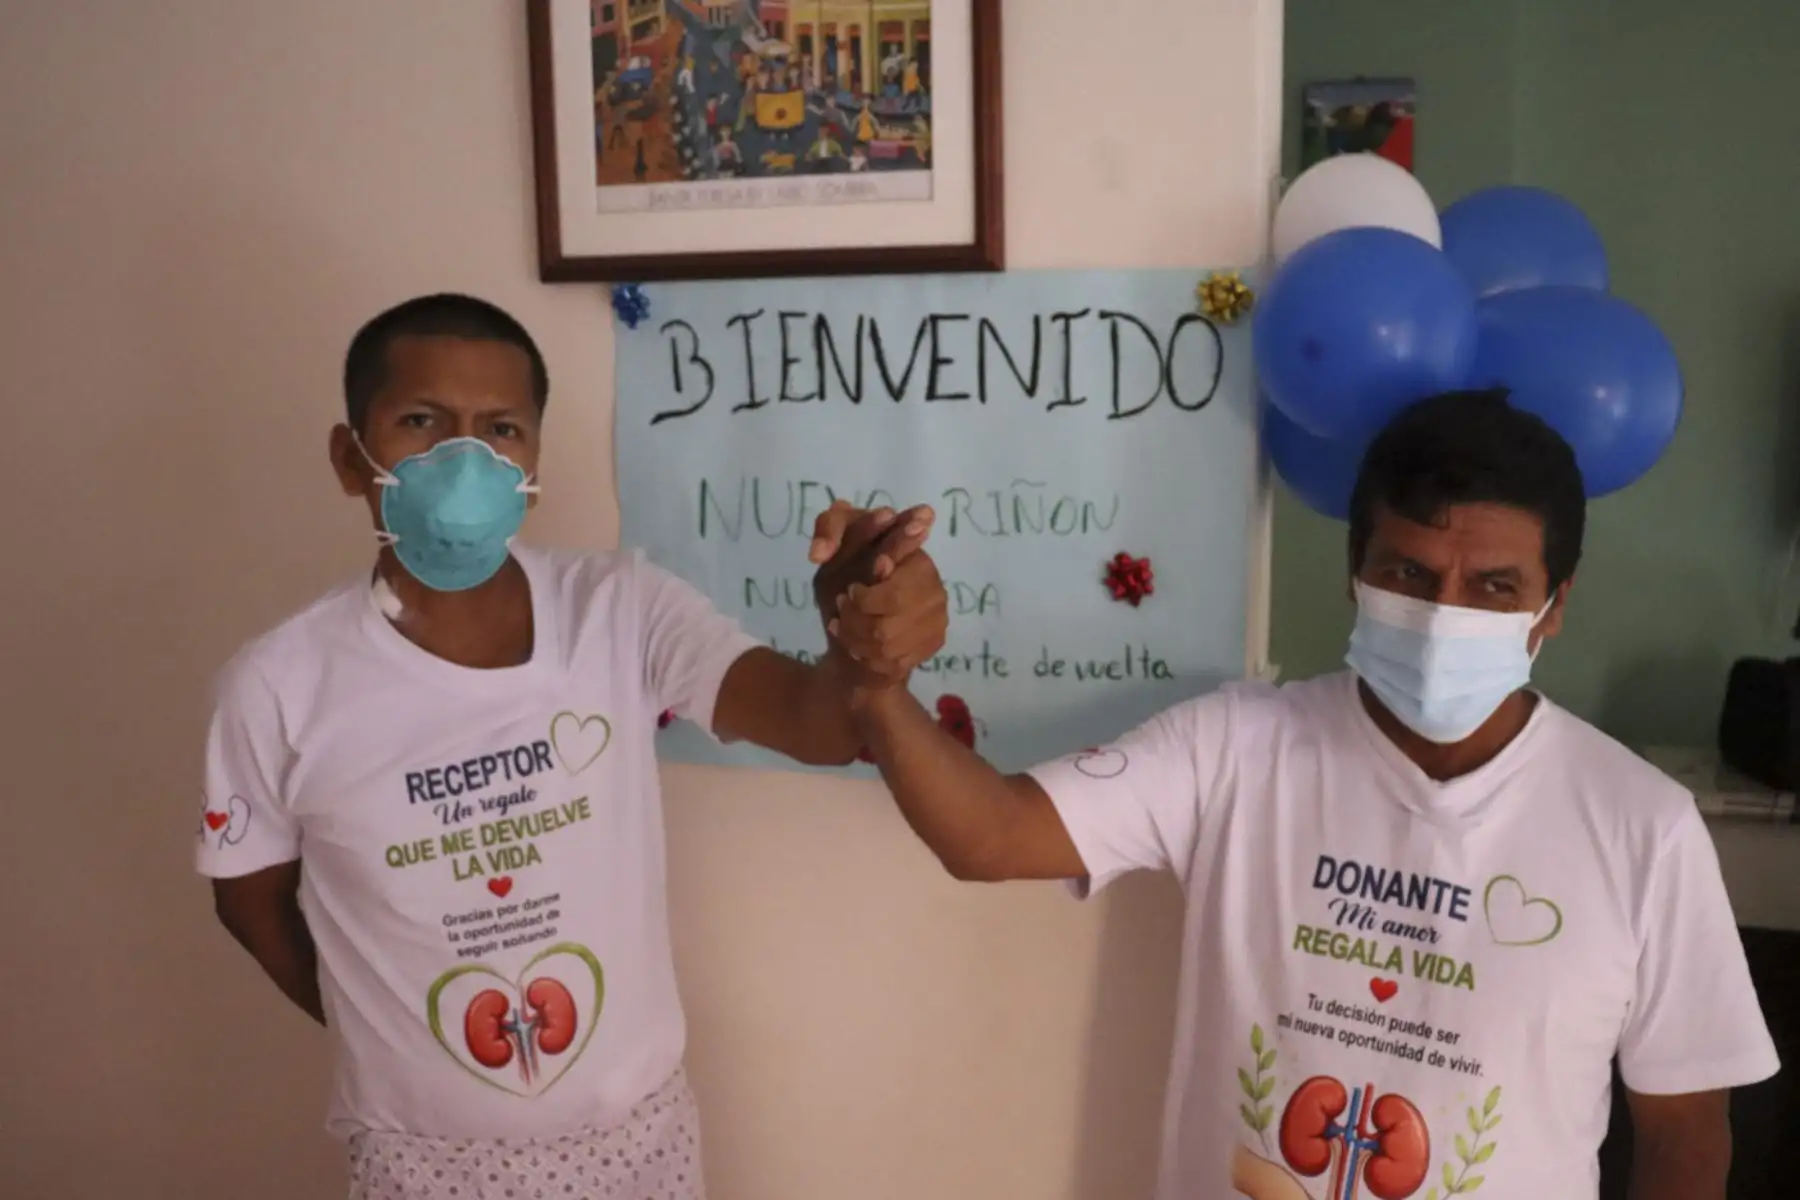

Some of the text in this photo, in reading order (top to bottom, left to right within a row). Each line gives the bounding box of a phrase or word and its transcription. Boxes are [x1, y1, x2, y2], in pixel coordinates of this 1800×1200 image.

[649, 308, 1225, 427] BIENVENIDO
[942, 479, 1121, 538] RIÑON
[1033, 645, 1066, 678] de
[405, 740, 554, 804] RECEPTOR
[433, 784, 538, 826] Un regalo
[385, 796, 592, 869] QUE ME DEVUELVE
[452, 842, 543, 881] LA VIDA
[442, 892, 560, 927] Gracias por darme
[1312, 854, 1472, 923] DONANTE
[447, 909, 560, 943] la oportunidad de
[1327, 898, 1443, 945] Mi amor
[456, 941, 499, 958] seguir
[1292, 924, 1476, 992] REGALA VIDA
[1277, 1012, 1485, 1078] mi nueva oportunidad de vivir.
[1307, 993, 1461, 1046] Tu decisión puede ser
